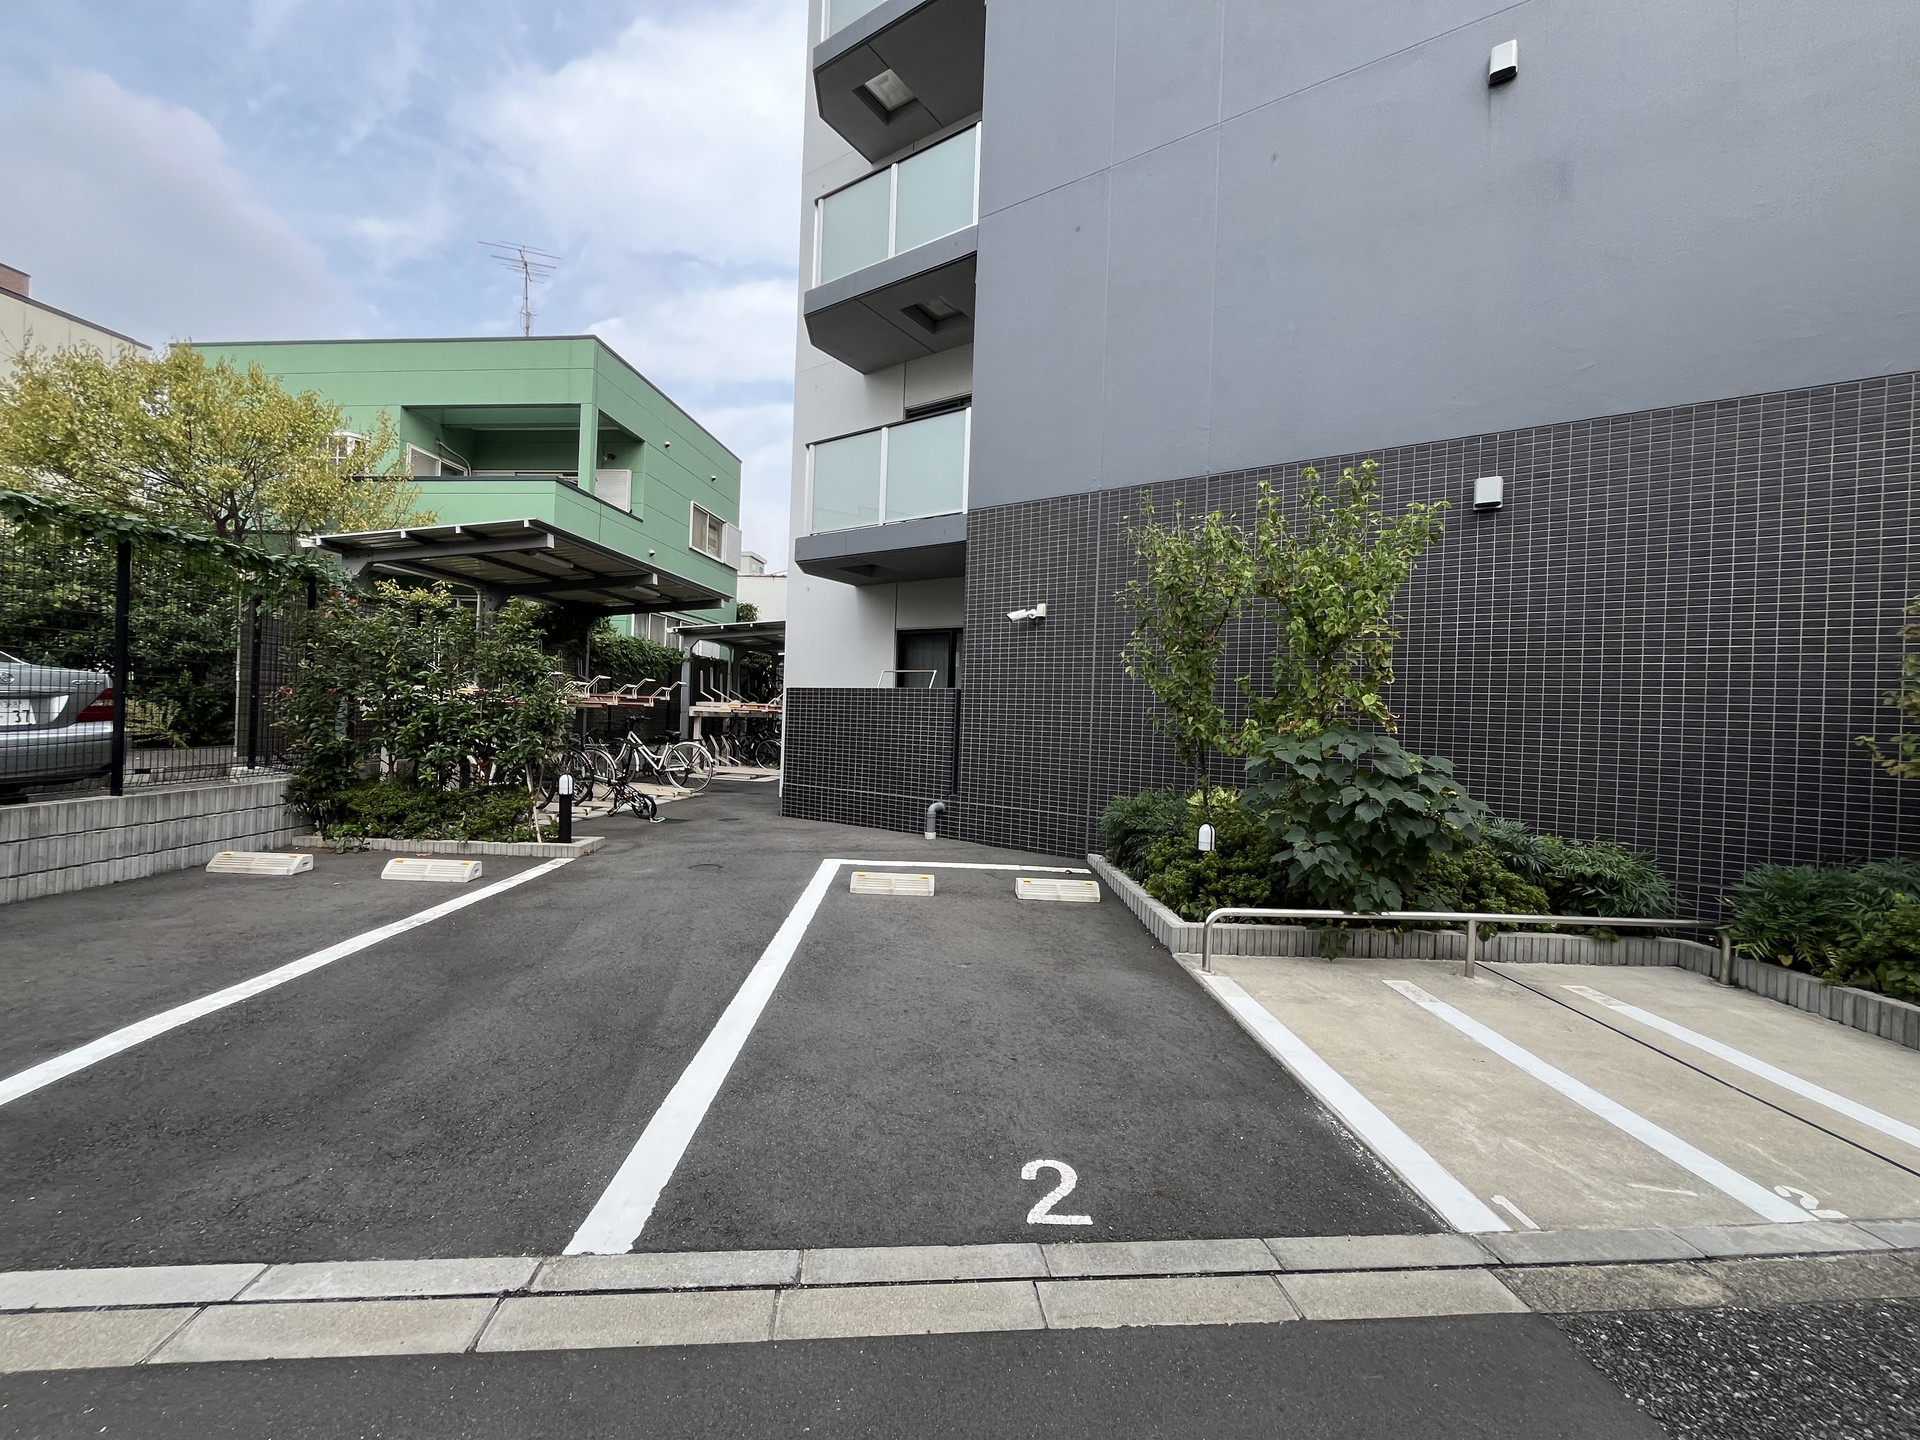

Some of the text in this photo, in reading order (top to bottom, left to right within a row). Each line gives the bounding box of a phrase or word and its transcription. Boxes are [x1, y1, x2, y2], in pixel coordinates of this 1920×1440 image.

[1021, 1159, 1094, 1225] 2
[1774, 1184, 1850, 1219] 2
[1490, 1194, 1541, 1230] 1
